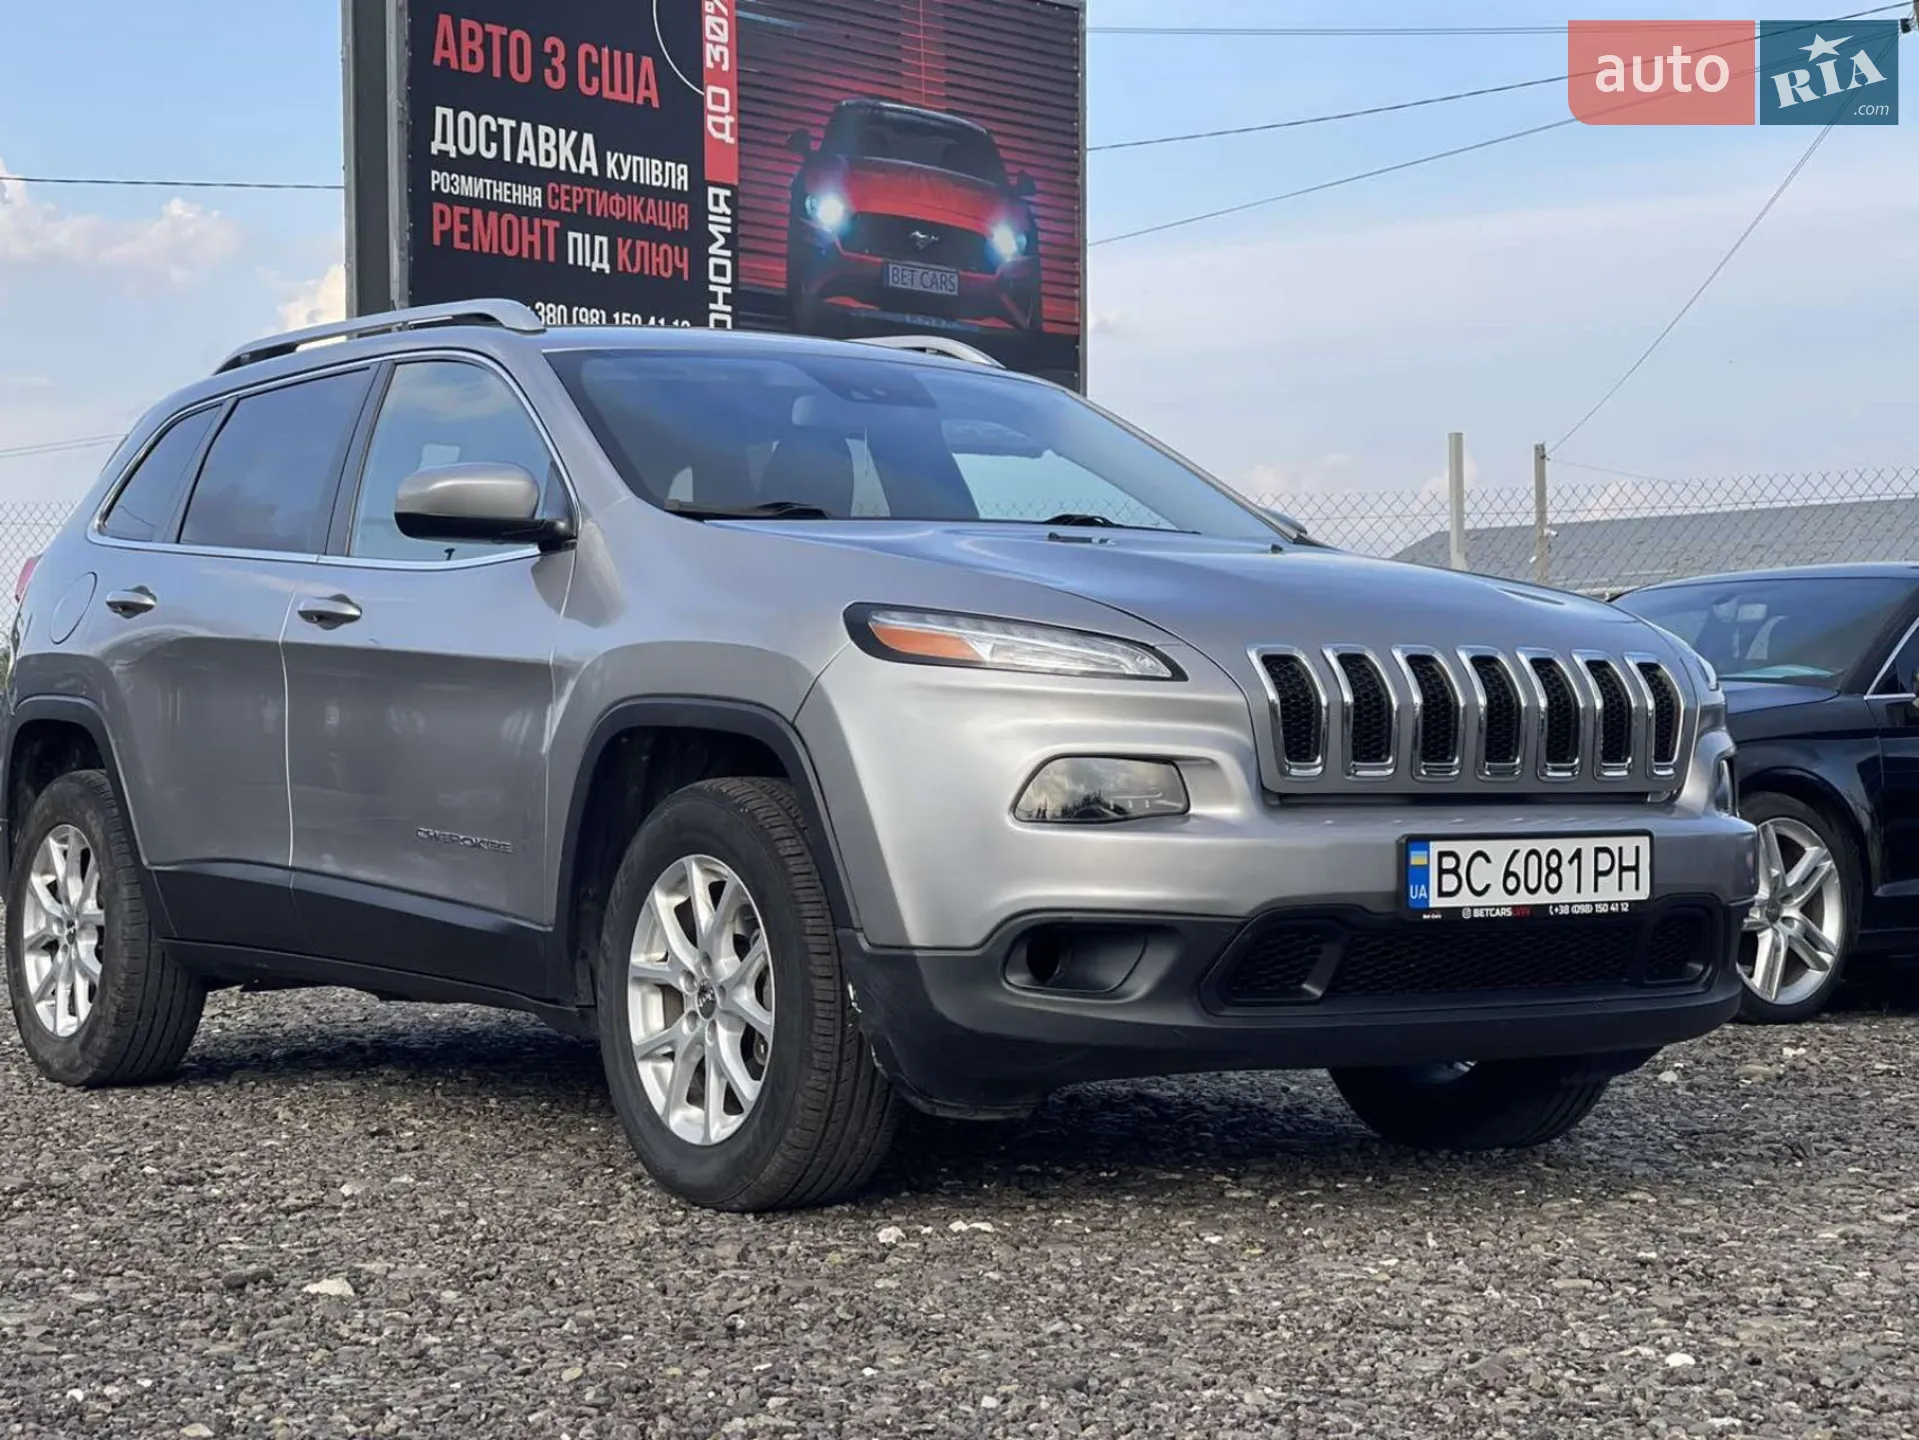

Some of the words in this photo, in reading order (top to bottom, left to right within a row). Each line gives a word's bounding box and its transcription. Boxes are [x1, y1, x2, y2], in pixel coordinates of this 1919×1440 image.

[432, 13, 532, 84] АВТО
[577, 42, 660, 109] США
[706, 85, 735, 144] ДО
[430, 105, 599, 177] ДОСТАВКА
[605, 150, 689, 192] КУПІВЛЯ
[430, 169, 542, 209] РОЗМИТНЕННЯ
[546, 182, 689, 232] СЕРТИФІКАЦІЯ
[432, 201, 560, 263] РЕМОНТ
[567, 230, 611, 275] ПІД
[616, 237, 689, 281] КЛЮЧ
[891, 265, 916, 286] BET
[919, 269, 956, 293] CARS
[529, 301, 568, 325] 380
[1410, 884, 1428, 900] UA
[1437, 849, 1492, 898] BC
[1502, 847, 1583, 896] 6081
[1593, 845, 1640, 893] PH
